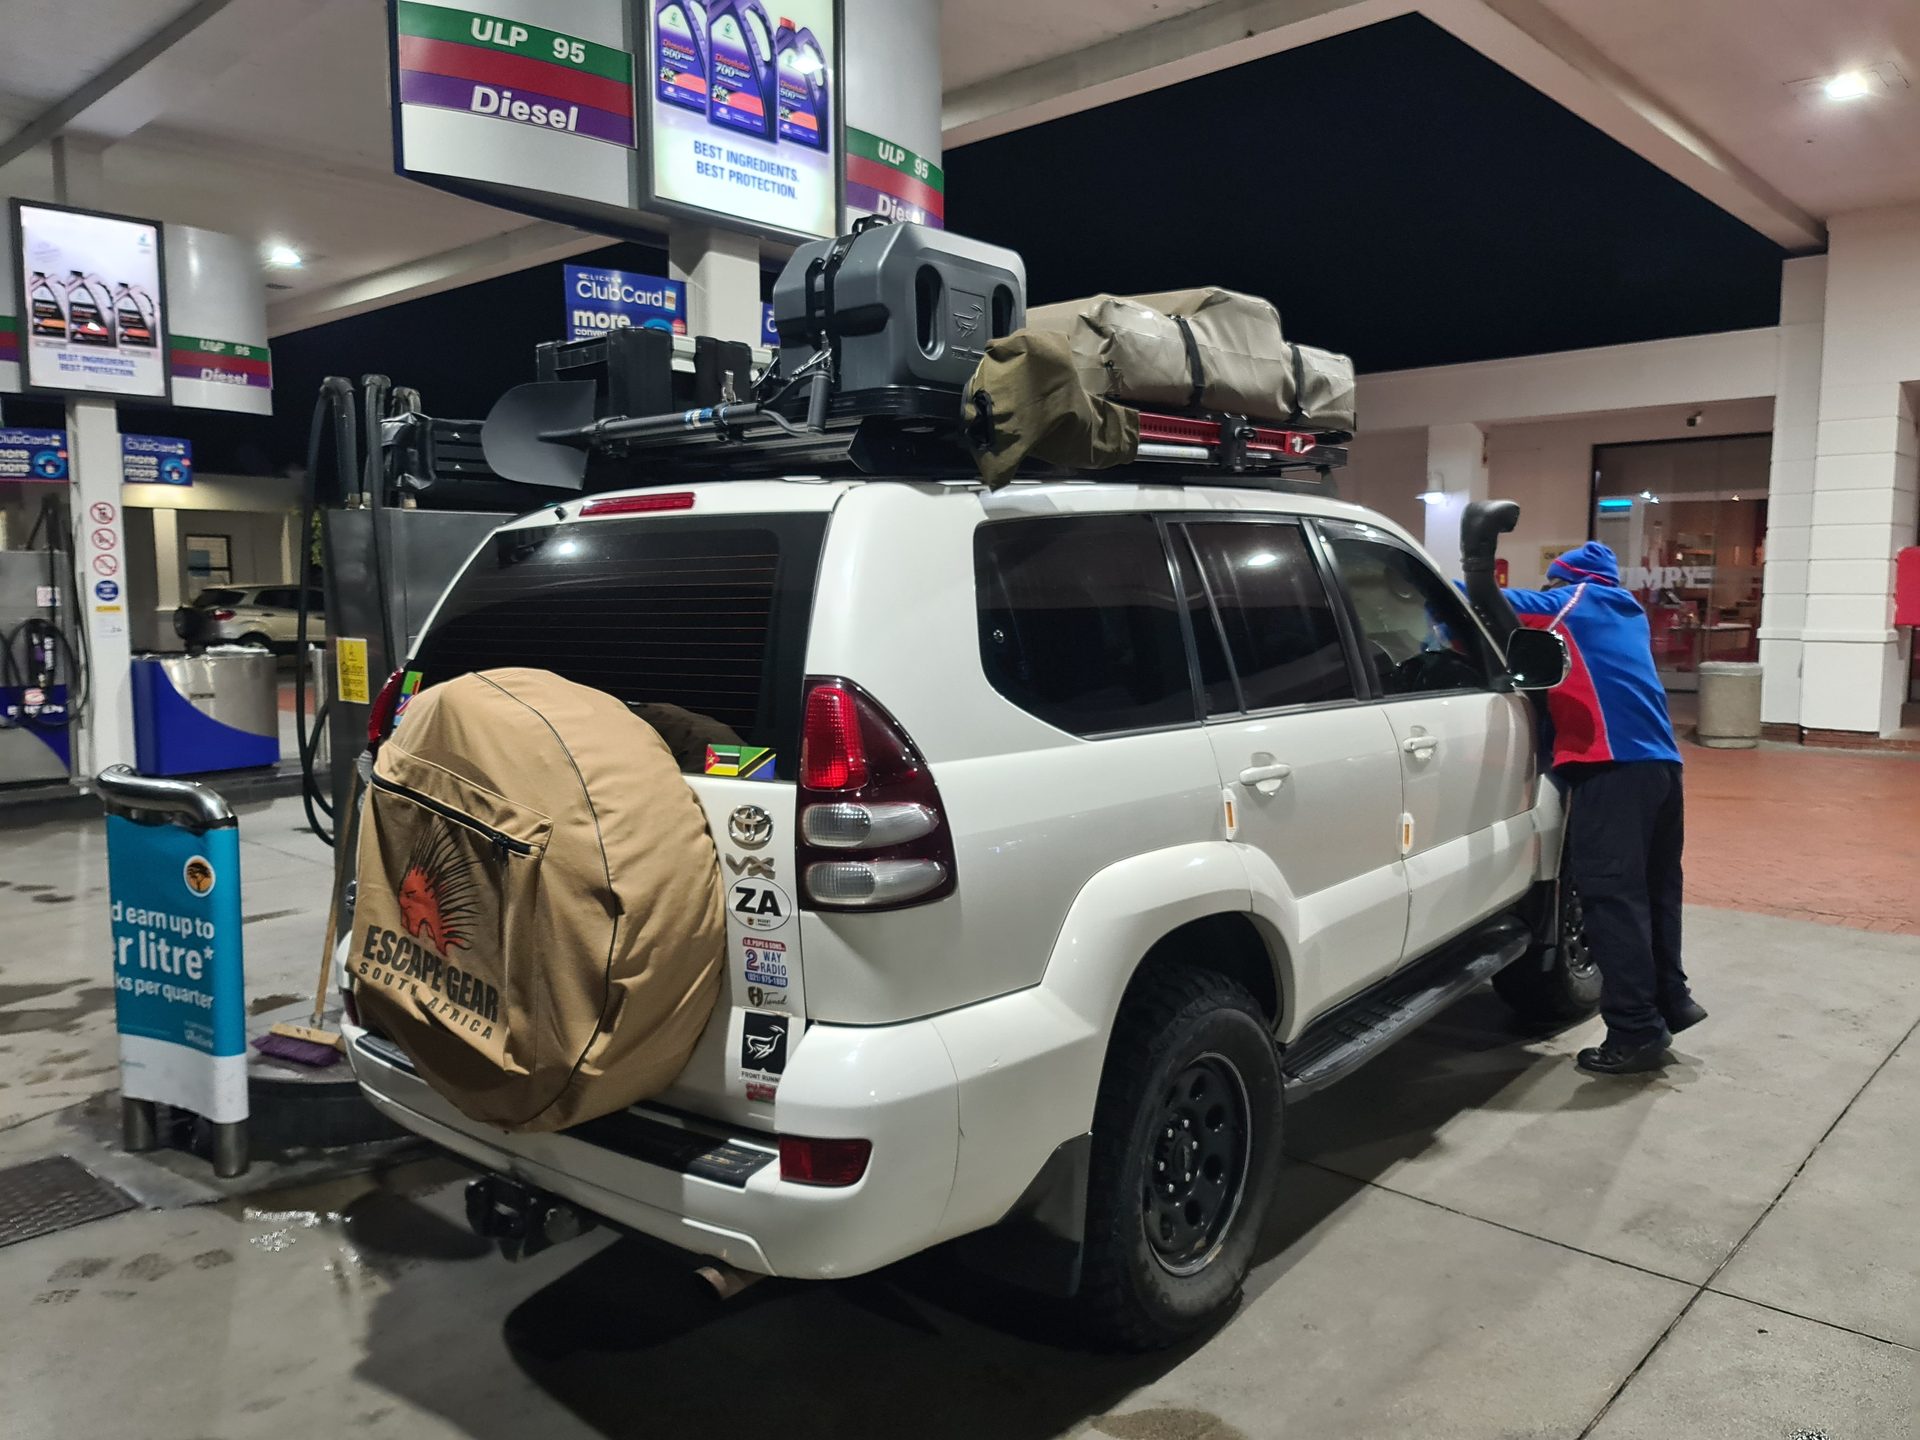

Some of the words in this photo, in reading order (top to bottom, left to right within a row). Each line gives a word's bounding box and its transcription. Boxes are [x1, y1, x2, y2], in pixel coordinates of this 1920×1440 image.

[470, 17, 529, 47] ULP
[552, 37, 586, 64] 95
[715, 62, 735, 77] 700
[471, 85, 579, 132] Diesel
[694, 140, 723, 160] BEST
[726, 149, 799, 182] INGREDIENTS.
[878, 141, 905, 166] ULP
[914, 158, 929, 179] 95
[696, 160, 725, 180] BEST
[728, 169, 798, 200] PROTECTION.
[877, 193, 926, 225] Diesl
[576, 280, 663, 307] ClubCard
[572, 310, 631, 329] more
[200, 367, 248, 385] Diesel
[1619, 566, 1697, 591] IMPY
[725, 853, 776, 880] VX
[735, 886, 782, 917] ZA
[125, 907, 167, 930] earn
[169, 914, 193, 939] up
[195, 917, 215, 939] to
[362, 924, 444, 992] ESCAPE
[446, 965, 500, 1024] GEAR
[745, 948, 760, 971] 2
[763, 951, 782, 963] WAY
[760, 962, 787, 976] RADIO
[134, 979, 161, 996] per
[162, 984, 214, 1009] quarter
[426, 997, 493, 1040] AFRICA
[741, 1070, 760, 1080] FRONT
